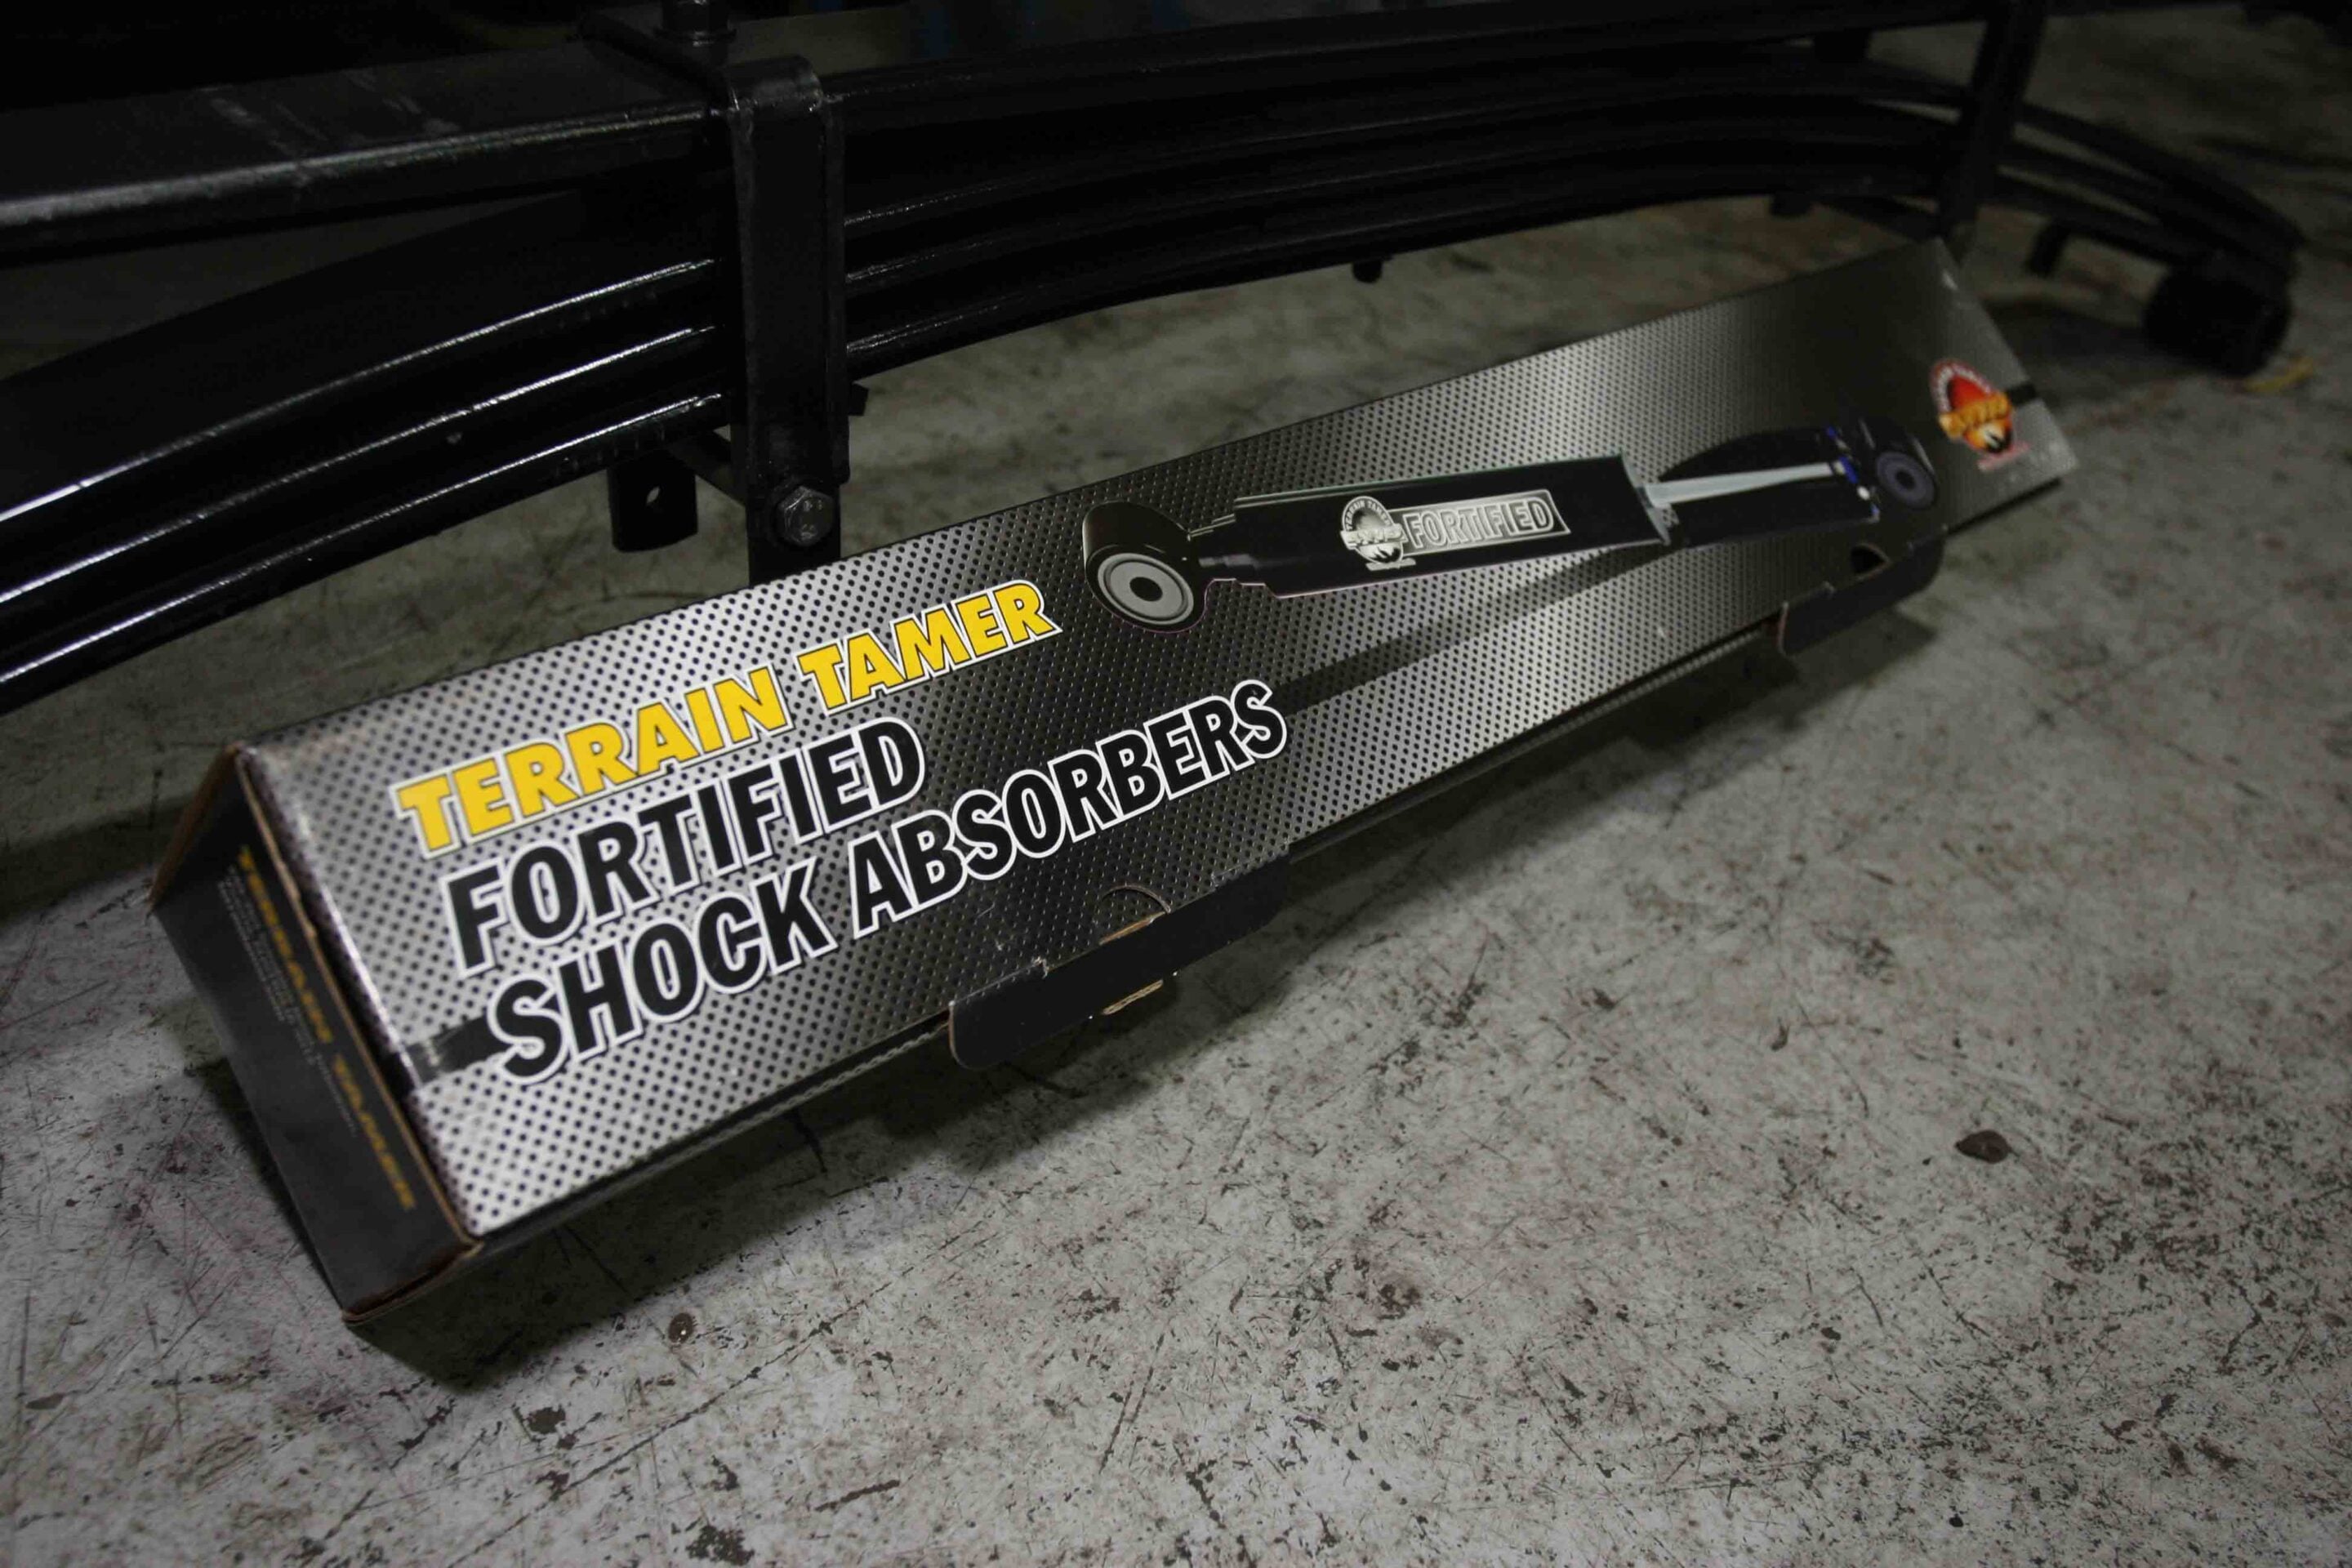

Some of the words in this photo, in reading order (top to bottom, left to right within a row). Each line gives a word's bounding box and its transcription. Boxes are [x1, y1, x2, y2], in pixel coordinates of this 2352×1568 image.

[1402, 496, 1554, 549] FORTIFIED
[390, 662, 794, 859] TERRAIN
[795, 578, 1063, 717] TAMER
[439, 716, 925, 978] FORTIFIED
[488, 857, 840, 1085] SHOCK
[846, 679, 1288, 940] ABSORBERS
